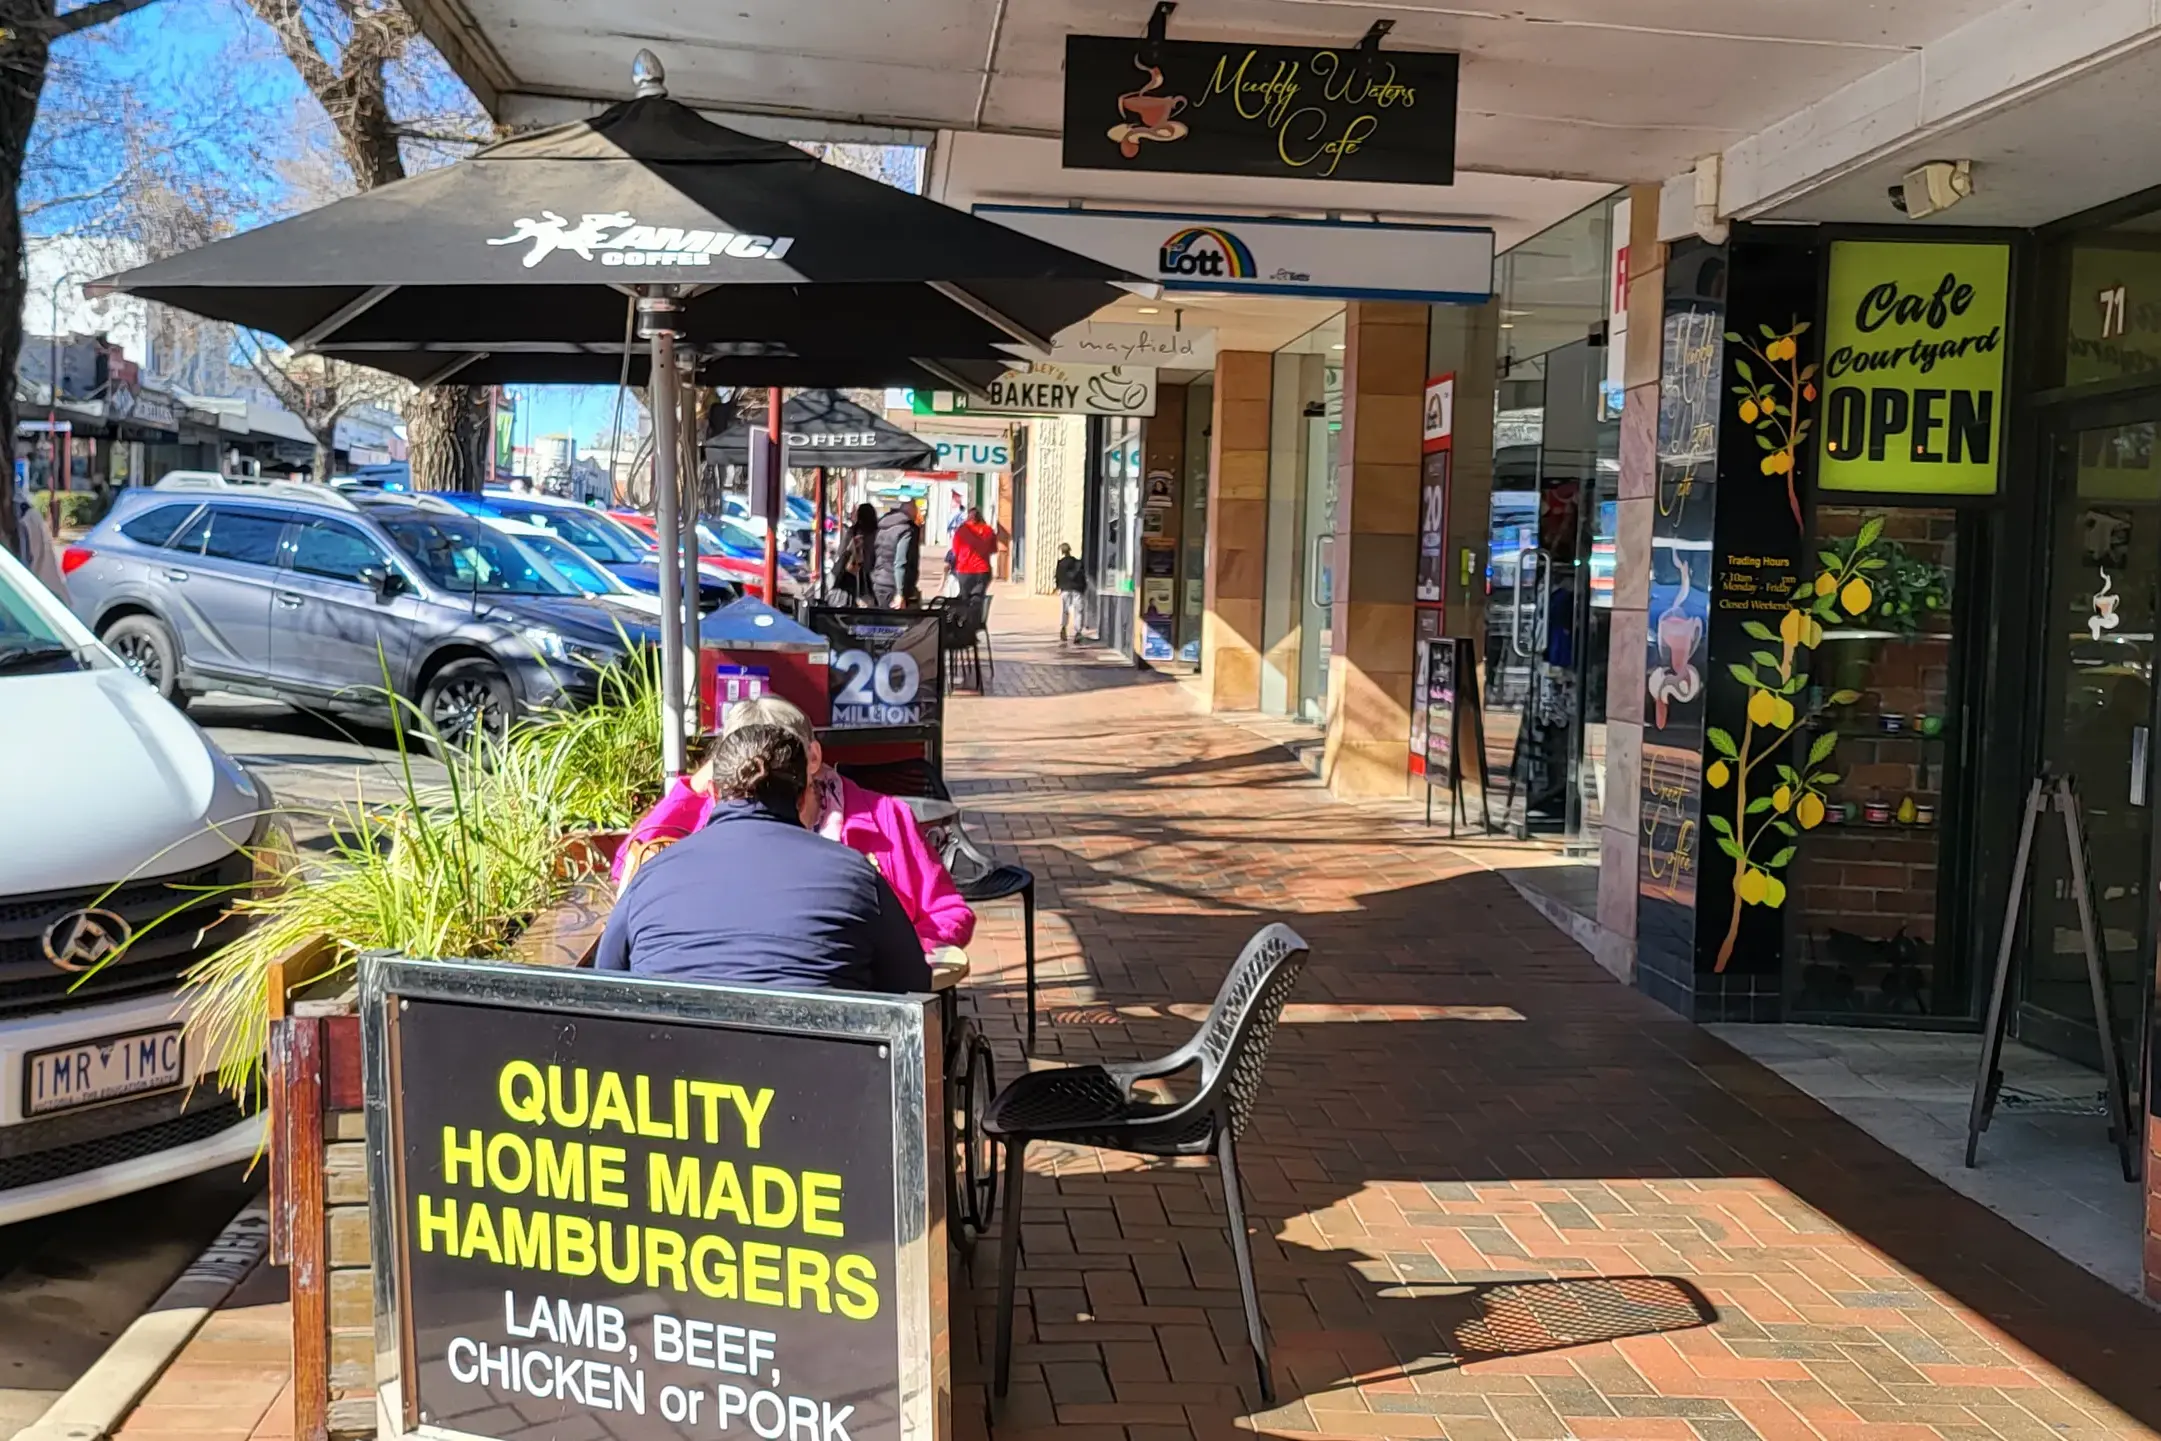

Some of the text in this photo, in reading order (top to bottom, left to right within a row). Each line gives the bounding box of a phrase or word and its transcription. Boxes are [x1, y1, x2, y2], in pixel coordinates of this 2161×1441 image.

[1193, 50, 1416, 128] Muddy Waters
[601, 251, 712, 266] COFFEE
[1159, 246, 1223, 276] Lott
[1855, 272, 1976, 334] Cafe
[2099, 286, 2127, 338] 71
[1080, 330, 1194, 360] mayfield
[1826, 326, 2000, 379] Courtyard
[990, 381, 1080, 409] BAKERY
[787, 431, 877, 447] OFFEE
[1827, 386, 1993, 464] OPEN
[935, 442, 1008, 464] PTUS
[1727, 554, 1790, 569] Trading Hours
[1719, 599, 1749, 610] Closed
[832, 704, 920, 724] MILLION
[37, 1035, 177, 1100] 1MR 1MC
[499, 1060, 775, 1149] QUALITY
[443, 1126, 845, 1238] HOME MADE
[418, 1194, 880, 1321] HAMBURGERS
[504, 1290, 781, 1388] LAMB, BEEF,
[447, 1336, 855, 1441] CHICKEN or PORK
